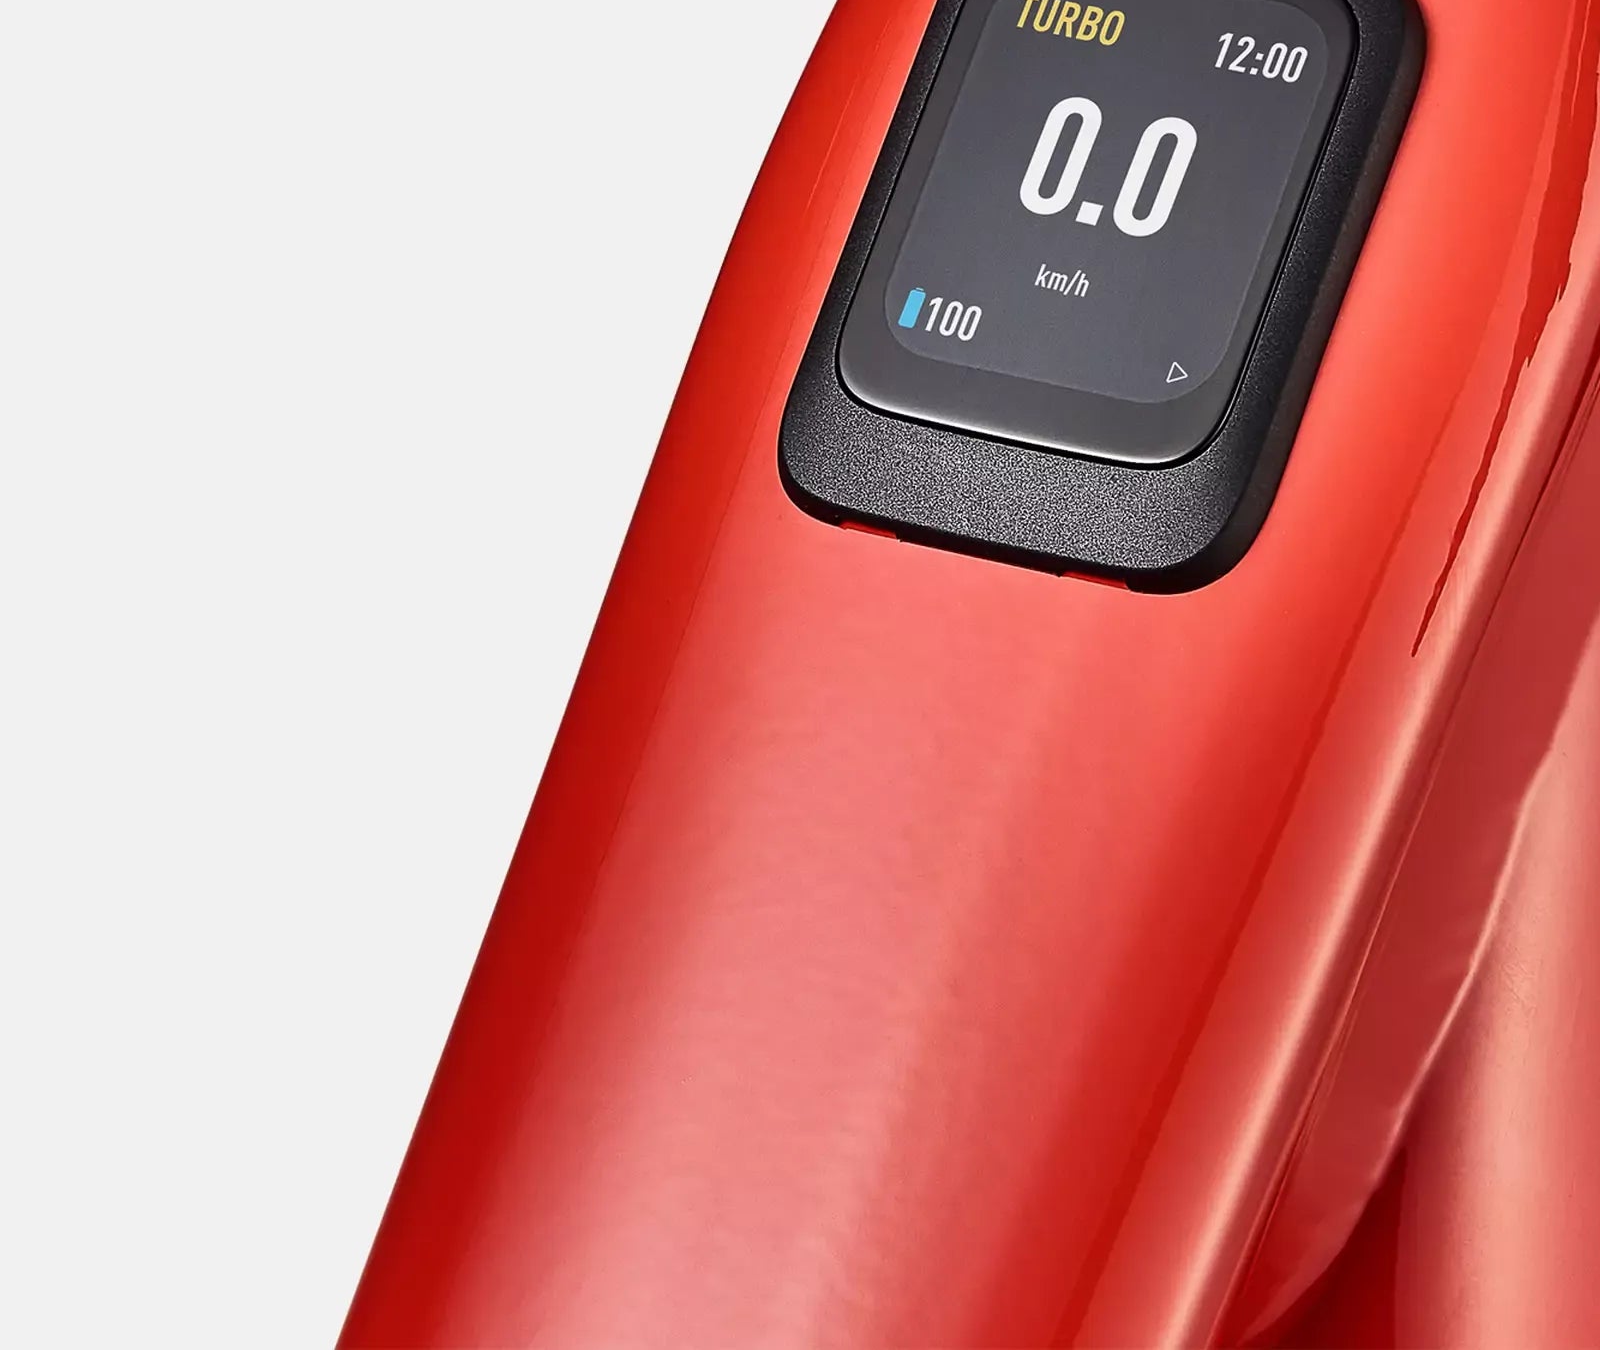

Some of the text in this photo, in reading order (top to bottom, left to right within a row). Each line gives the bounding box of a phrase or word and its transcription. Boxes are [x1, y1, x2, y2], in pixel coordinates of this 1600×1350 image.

[1214, 32, 1308, 83] 12:00
[1019, 96, 1198, 237] 0.0
[1034, 263, 1090, 298] km/h
[923, 296, 983, 342] 100
